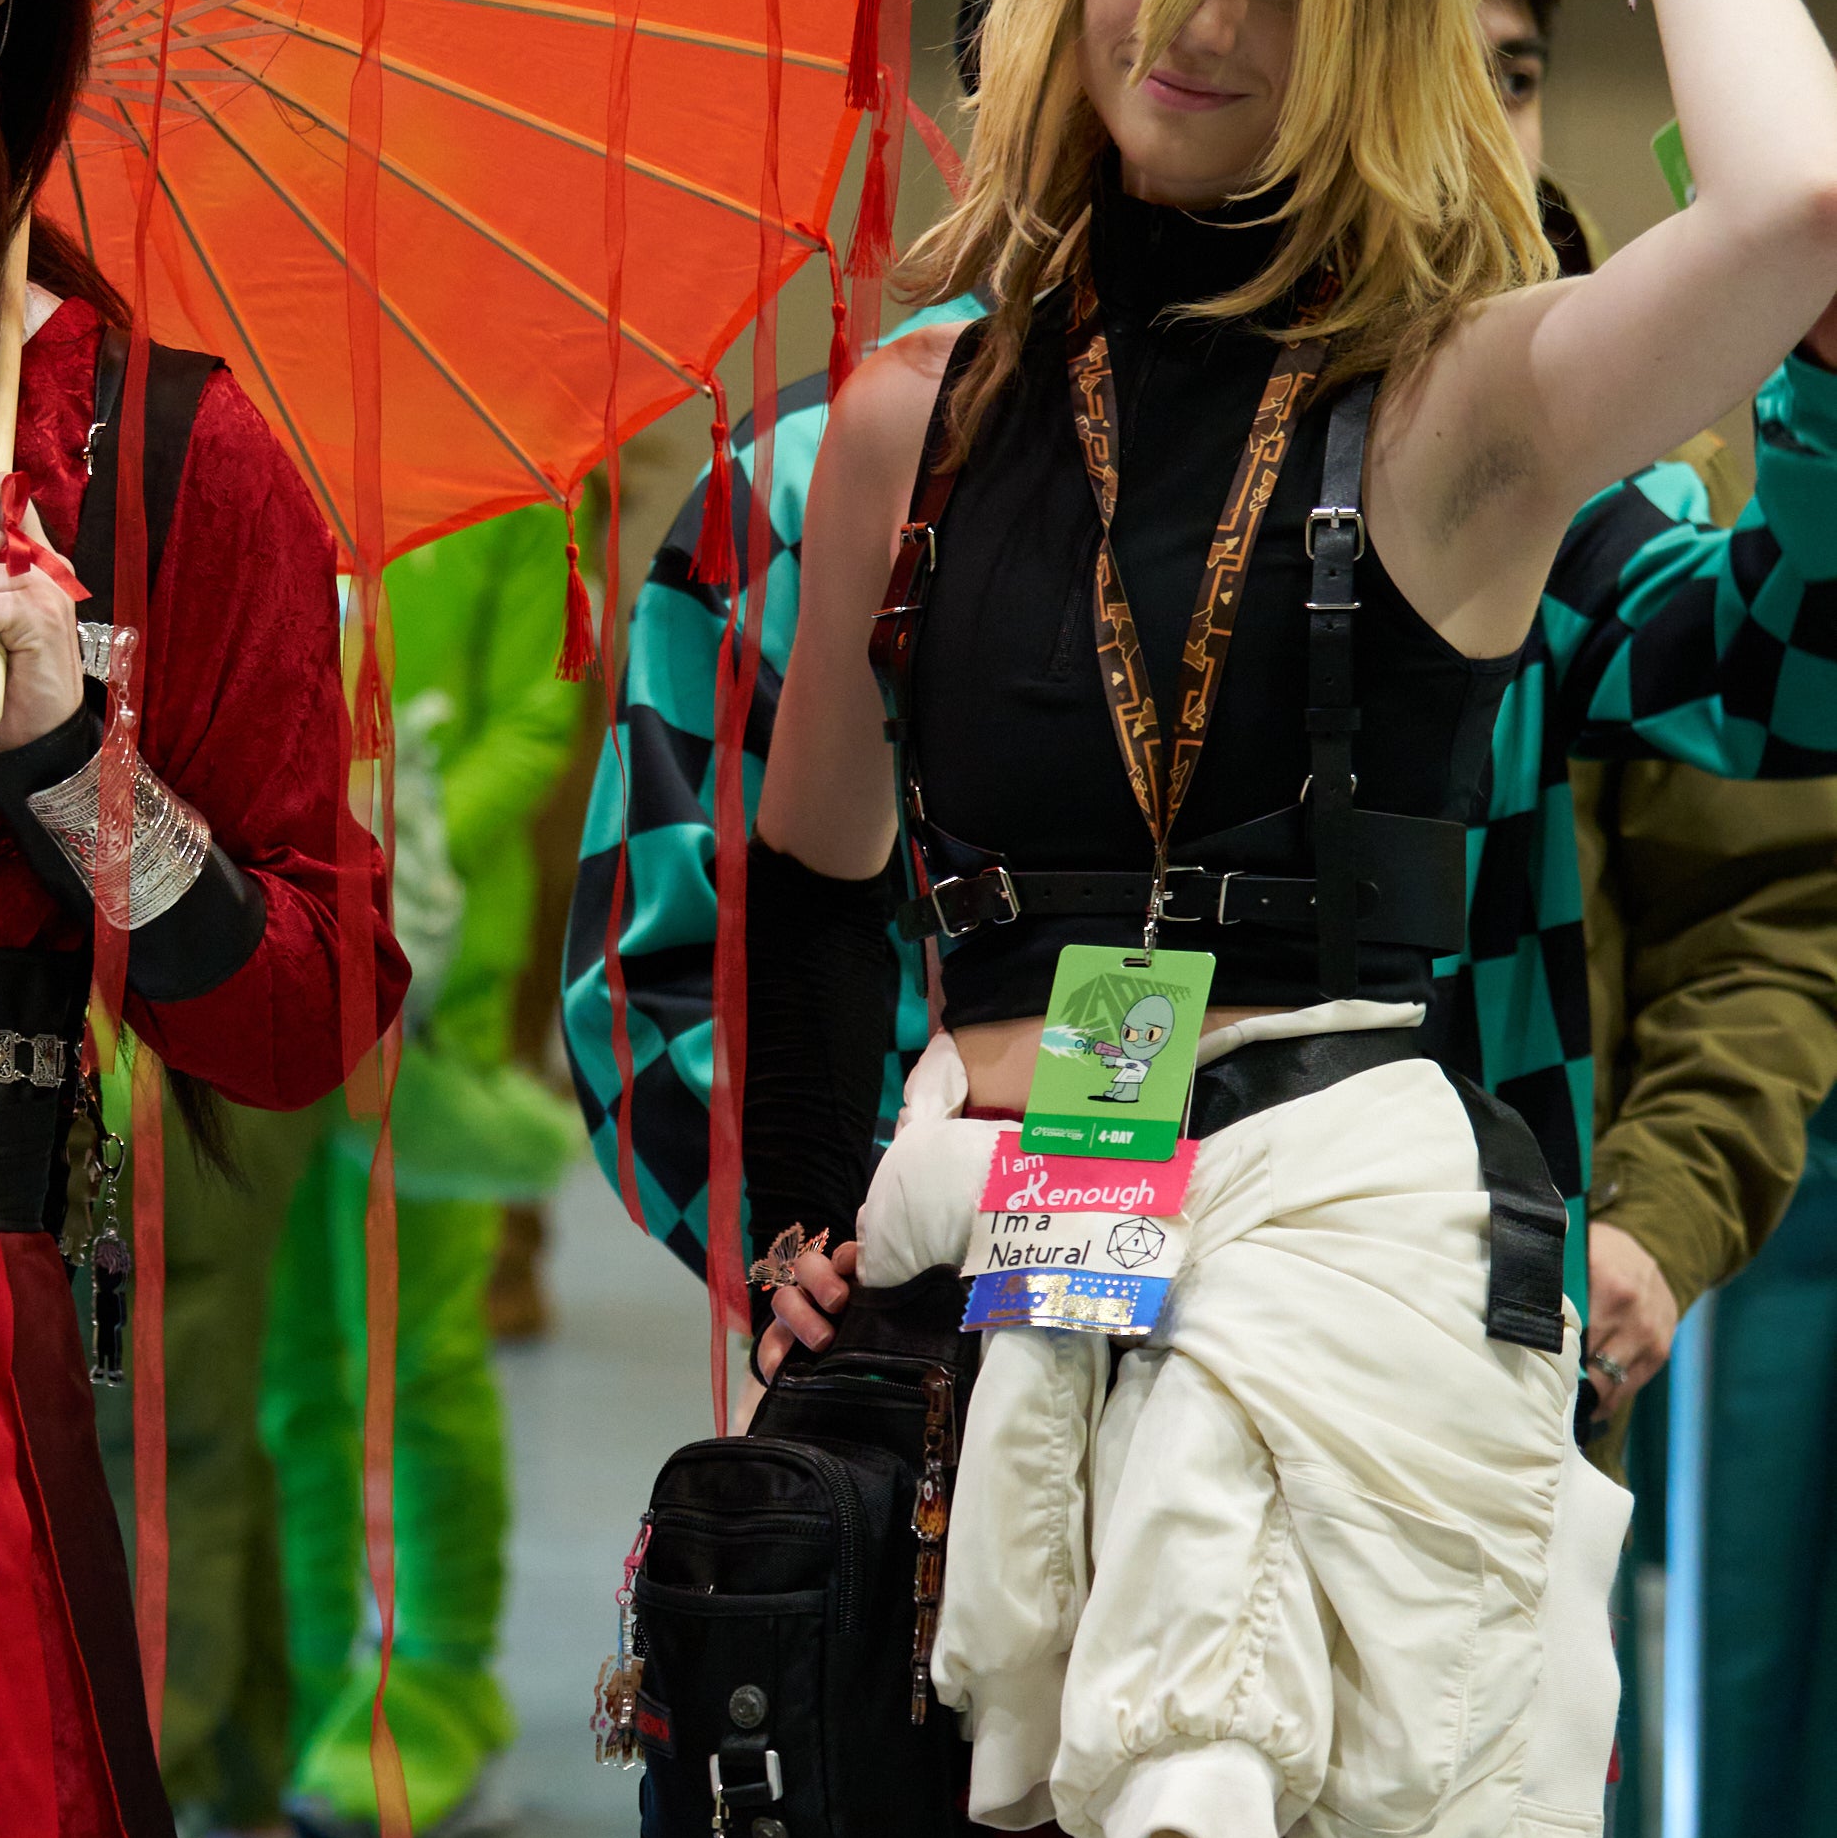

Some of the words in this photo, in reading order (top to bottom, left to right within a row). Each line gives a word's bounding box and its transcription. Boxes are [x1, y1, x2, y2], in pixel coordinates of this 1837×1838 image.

[1098, 1129, 1135, 1144] 4-DAY
[1001, 1155, 1007, 1176] I
[1013, 1154, 1044, 1173] am
[1006, 1170, 1155, 1212] Kenough
[991, 1211, 1029, 1234] Im
[1035, 1214, 1051, 1231] a
[987, 1239, 1091, 1269] Natural
